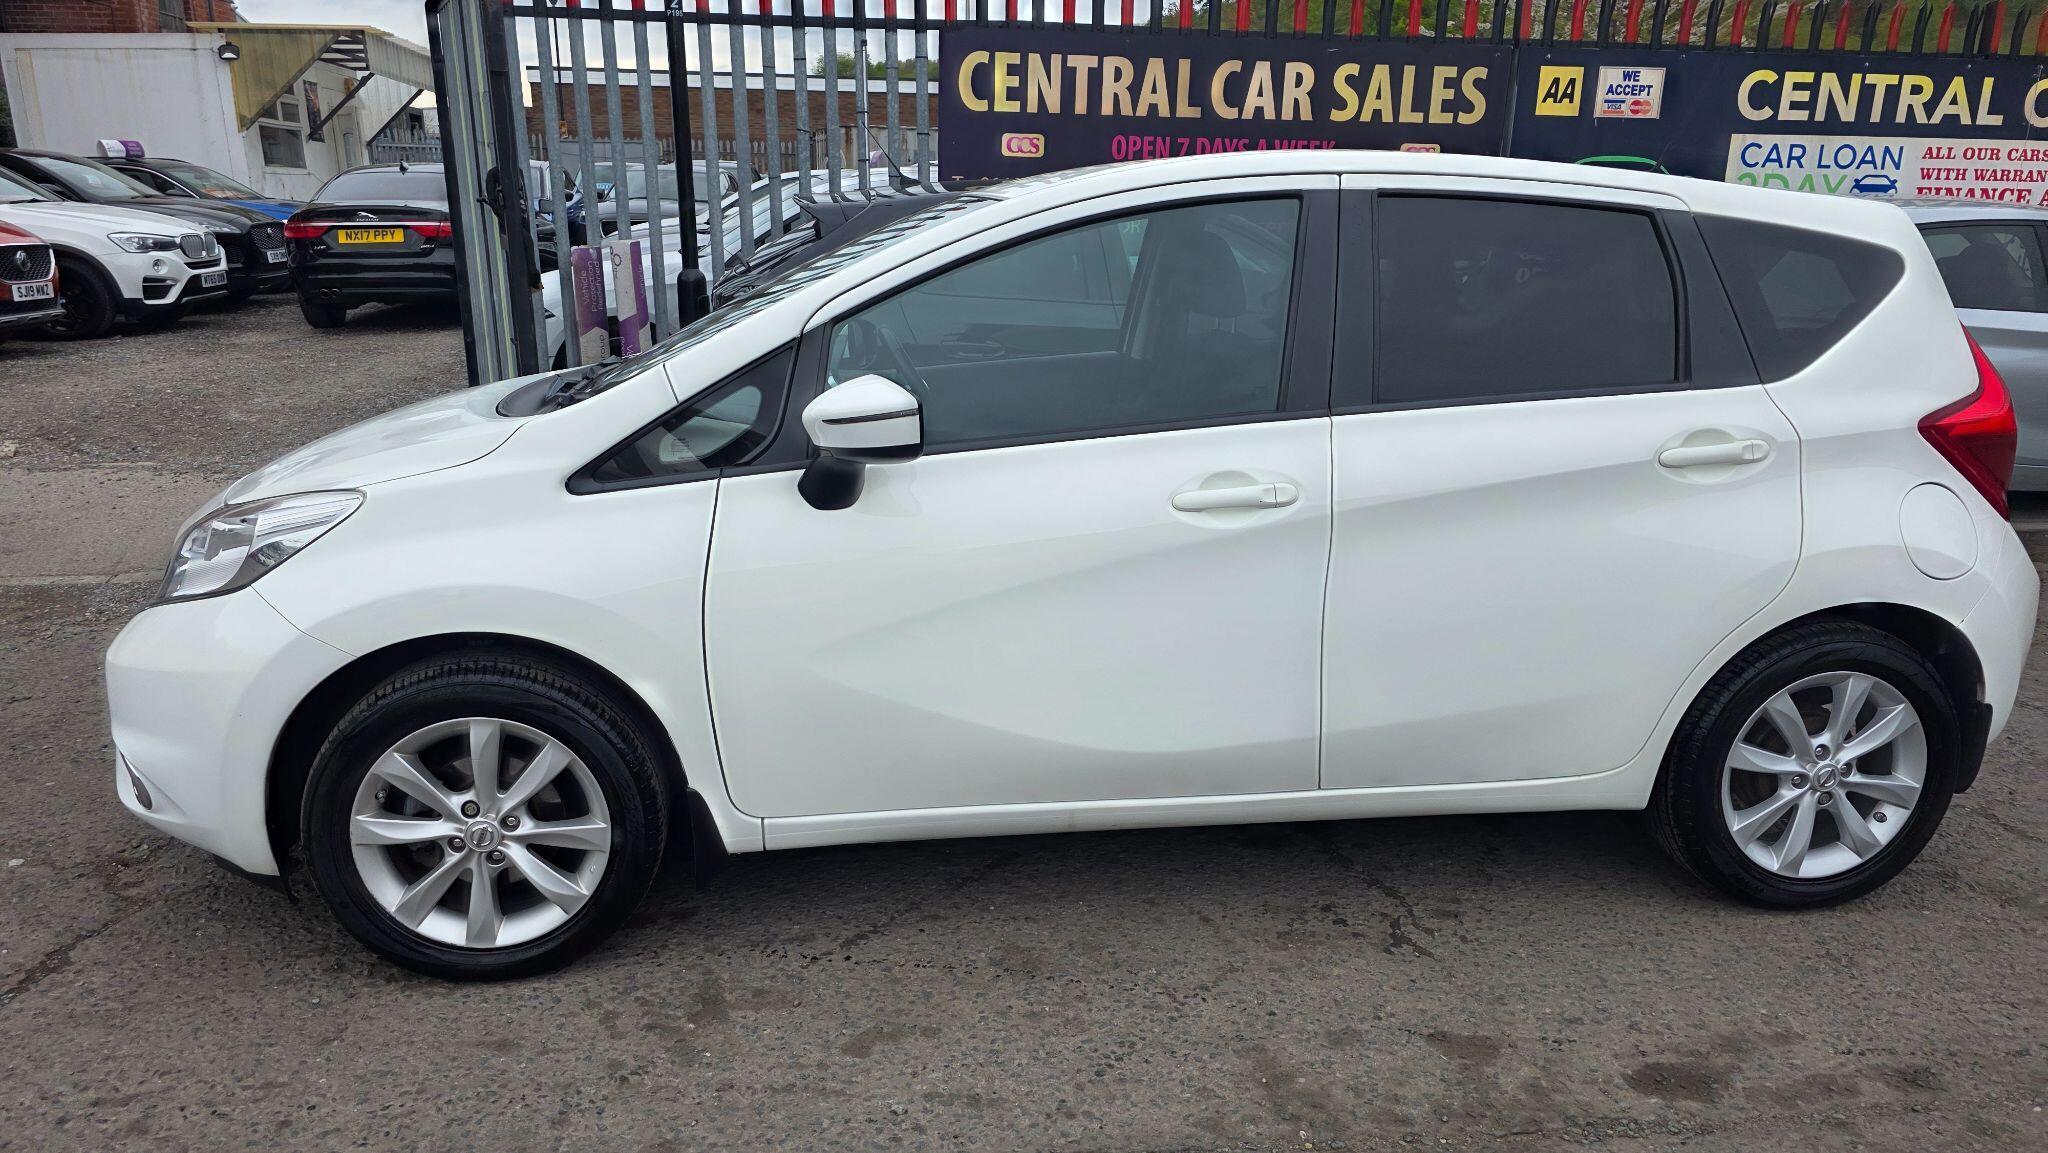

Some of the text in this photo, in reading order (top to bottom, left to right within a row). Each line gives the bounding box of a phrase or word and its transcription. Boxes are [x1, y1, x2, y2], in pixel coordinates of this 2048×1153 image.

[1622, 70, 1641, 82] WE
[958, 51, 1489, 125] CENTRAL CAR SALES
[1541, 77, 1577, 104] AA
[1605, 84, 1654, 97] ACCEPT
[1737, 69, 2004, 126] CENTRAL
[1111, 134, 1171, 160] OPEN
[1176, 137, 1190, 157] 7
[1195, 137, 1250, 156] DAYS
[1740, 142, 1904, 171] CAR LOAN
[1921, 146, 1957, 160] ALL
[1962, 147, 2001, 161] OUR
[1919, 167, 1969, 181] WITH
[345, 229, 396, 241] NX17 PPY
